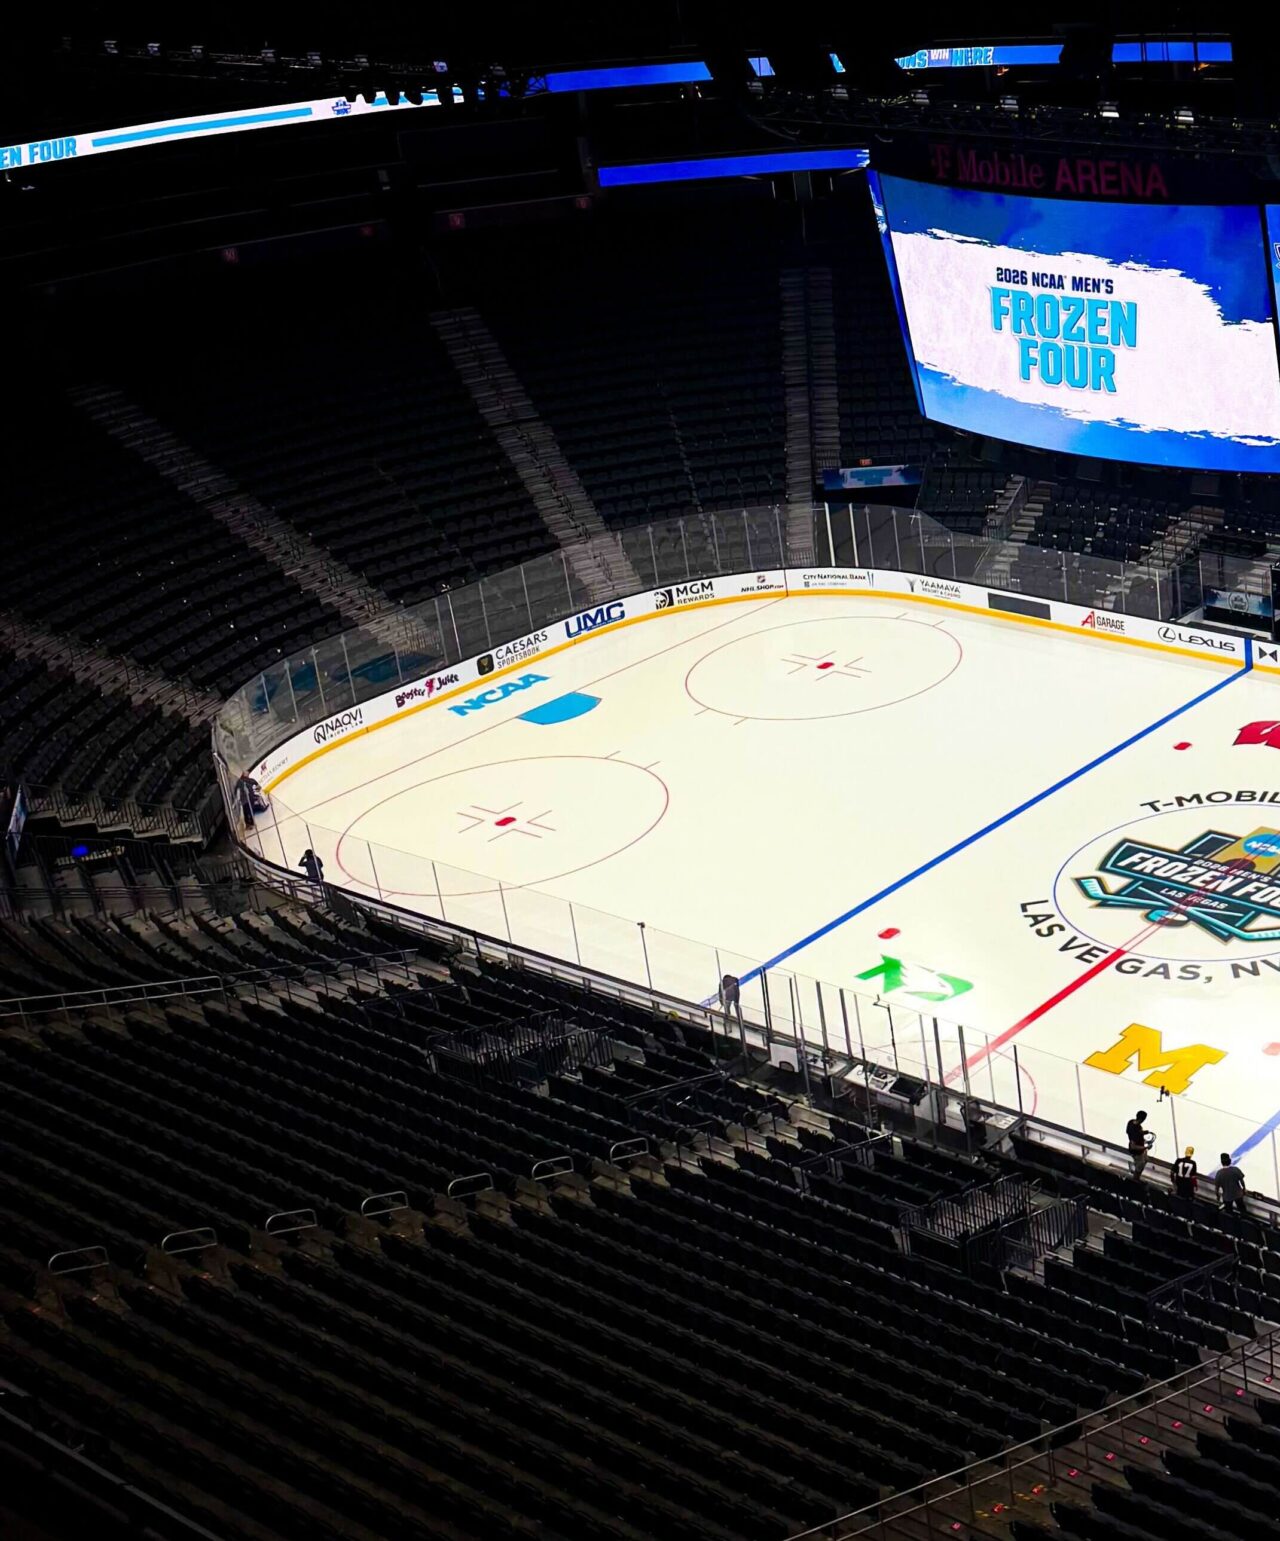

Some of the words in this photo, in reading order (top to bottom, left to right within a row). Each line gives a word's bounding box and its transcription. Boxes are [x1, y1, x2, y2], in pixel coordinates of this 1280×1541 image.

[930, 49, 949, 60] WIN
[950, 47, 994, 66] HERE
[29, 137, 77, 164] FOUR
[957, 147, 1044, 189] Mobile
[1054, 158, 1169, 198] ARENA
[996, 267, 1028, 286] 2026
[1032, 272, 1065, 290] NCAA
[1071, 276, 1114, 294] MEN'S
[989, 286, 1138, 348] FROZEN
[1018, 337, 1117, 393] FOUR
[675, 580, 714, 598] MGM
[677, 593, 715, 605] REWARDS
[565, 602, 625, 638] UMC
[1096, 616, 1125, 631] GARAGE
[495, 631, 548, 659] CAESARS
[1178, 633, 1235, 652] LEXUS
[497, 645, 540, 669] SPORTSBOOK
[448, 673, 551, 716] NCAA
[325, 707, 363, 734] NAQVI
[1117, 851, 1238, 893] FROZEN
[1192, 859, 1231, 874] 2026
[1228, 868, 1272, 884] MEN'S
[1160, 887, 1184, 898] LAS
[1187, 894, 1227, 910] VEGAS
[1020, 899, 1066, 938] LAS
[1082, 1022, 1229, 1095] M
[1178, 1161, 1194, 1178] 17
